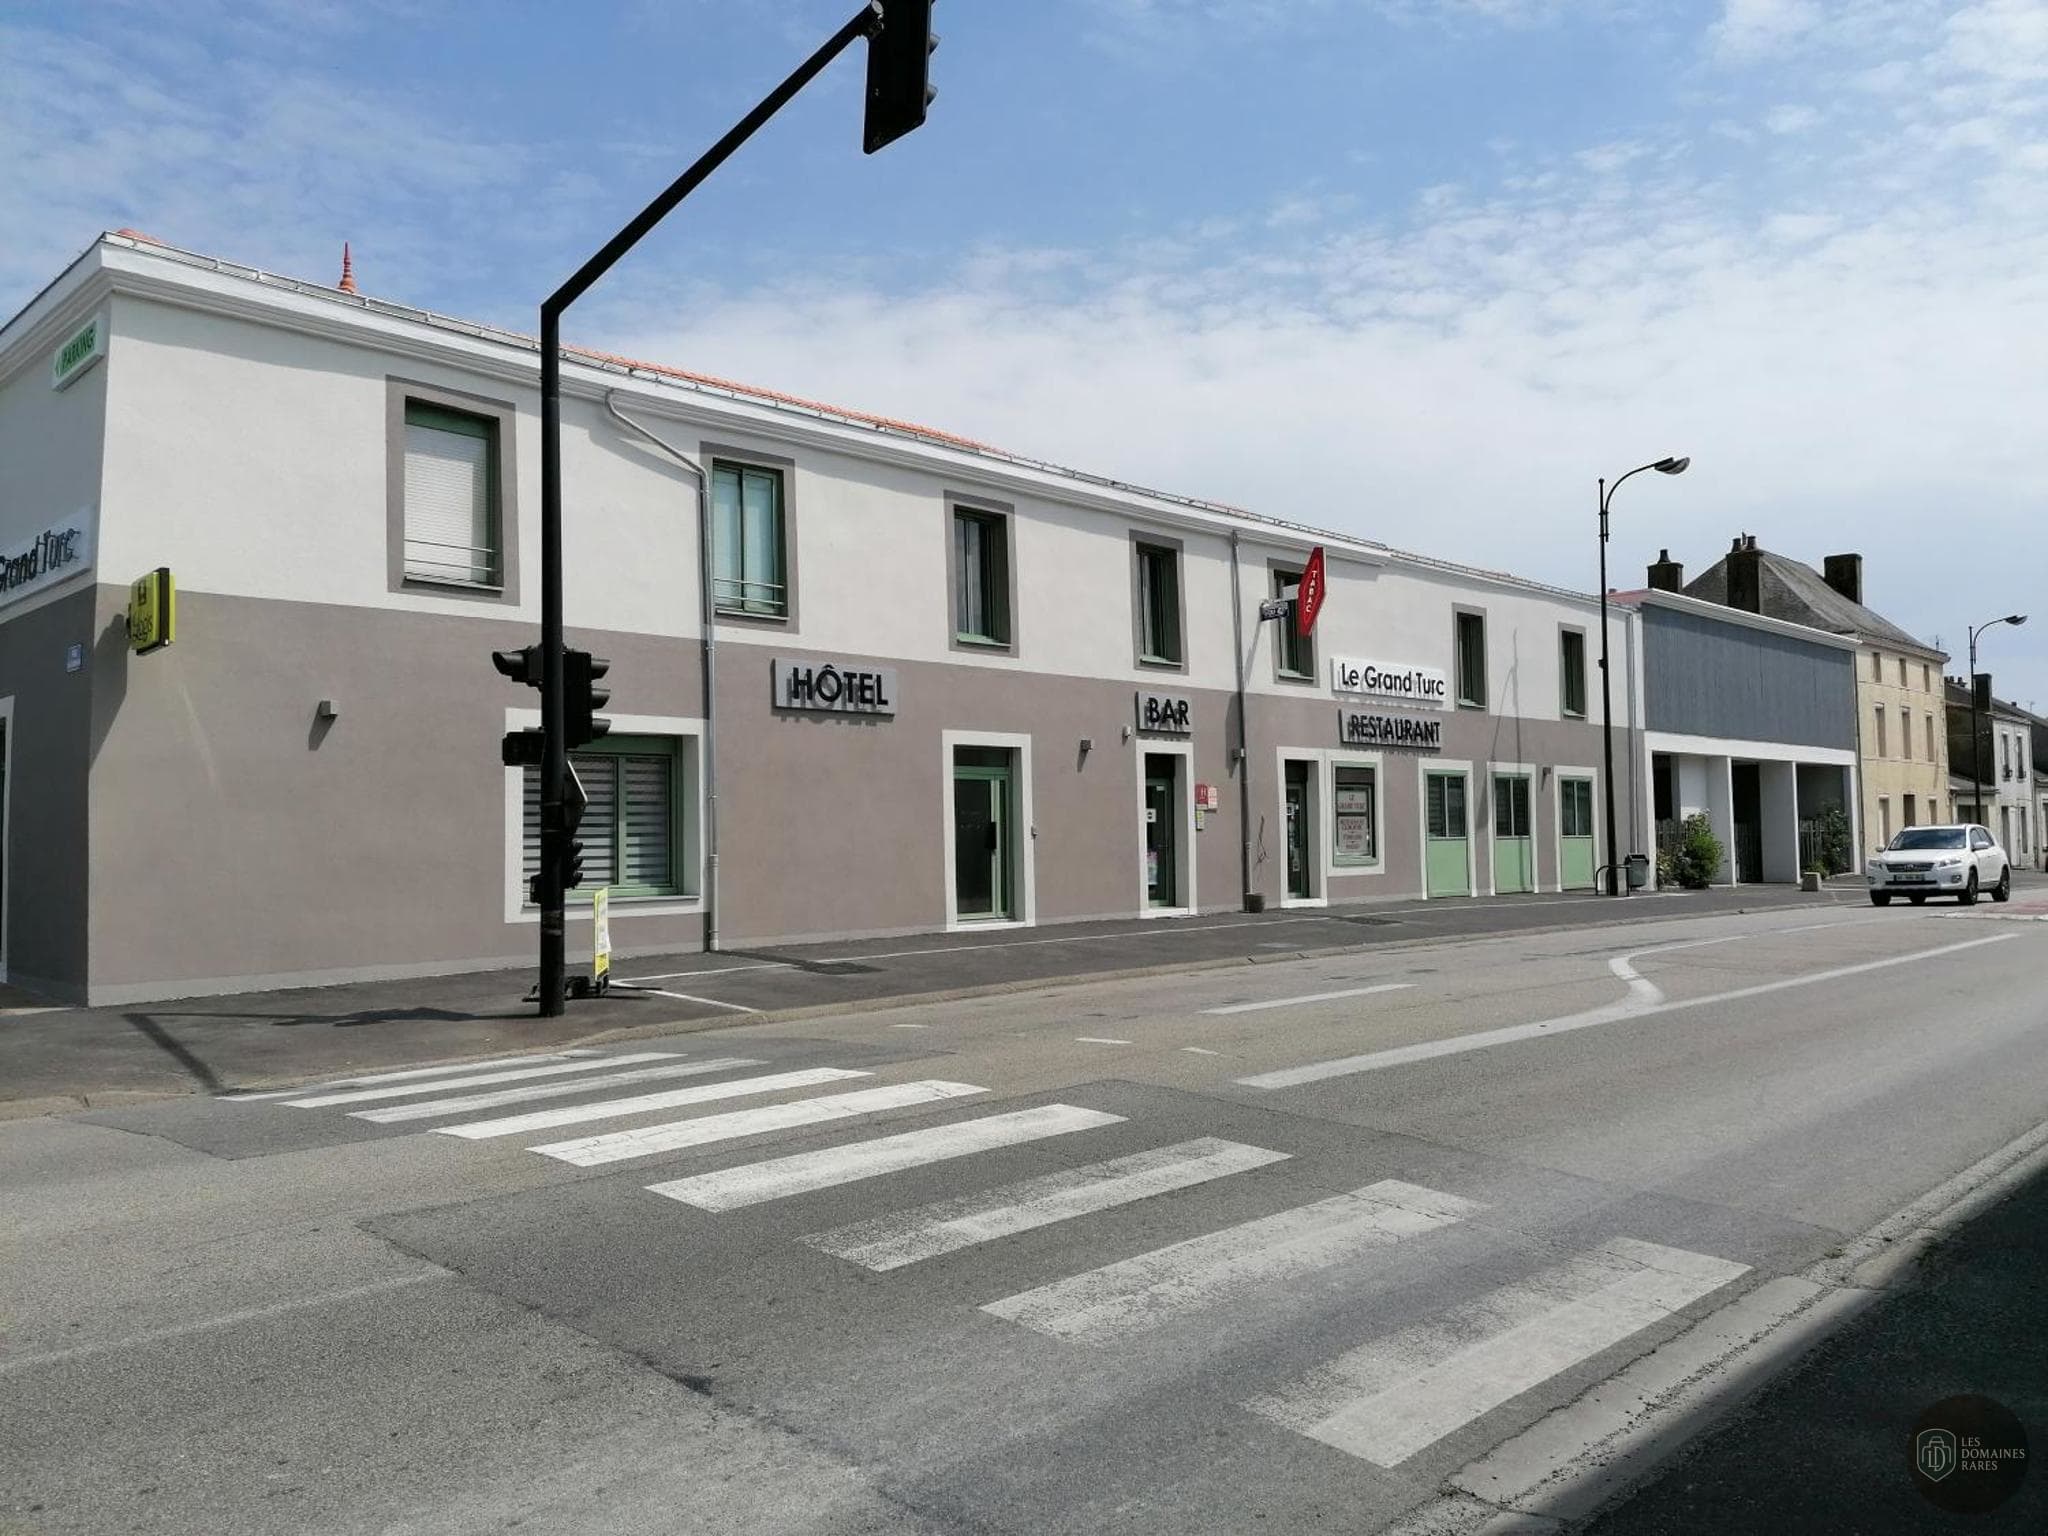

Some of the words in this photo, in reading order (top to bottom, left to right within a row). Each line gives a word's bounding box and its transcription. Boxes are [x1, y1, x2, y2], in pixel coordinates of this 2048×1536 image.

[61, 326, 96, 368] PARKING
[1305, 570, 1318, 612] TABAC
[792, 664, 889, 705] HÔTEL
[1341, 663, 1359, 686] Le
[1364, 665, 1412, 692] Grand
[1415, 672, 1445, 695] Turc
[1147, 697, 1190, 725] BAR
[1350, 714, 1440, 743] RESTAURANT
